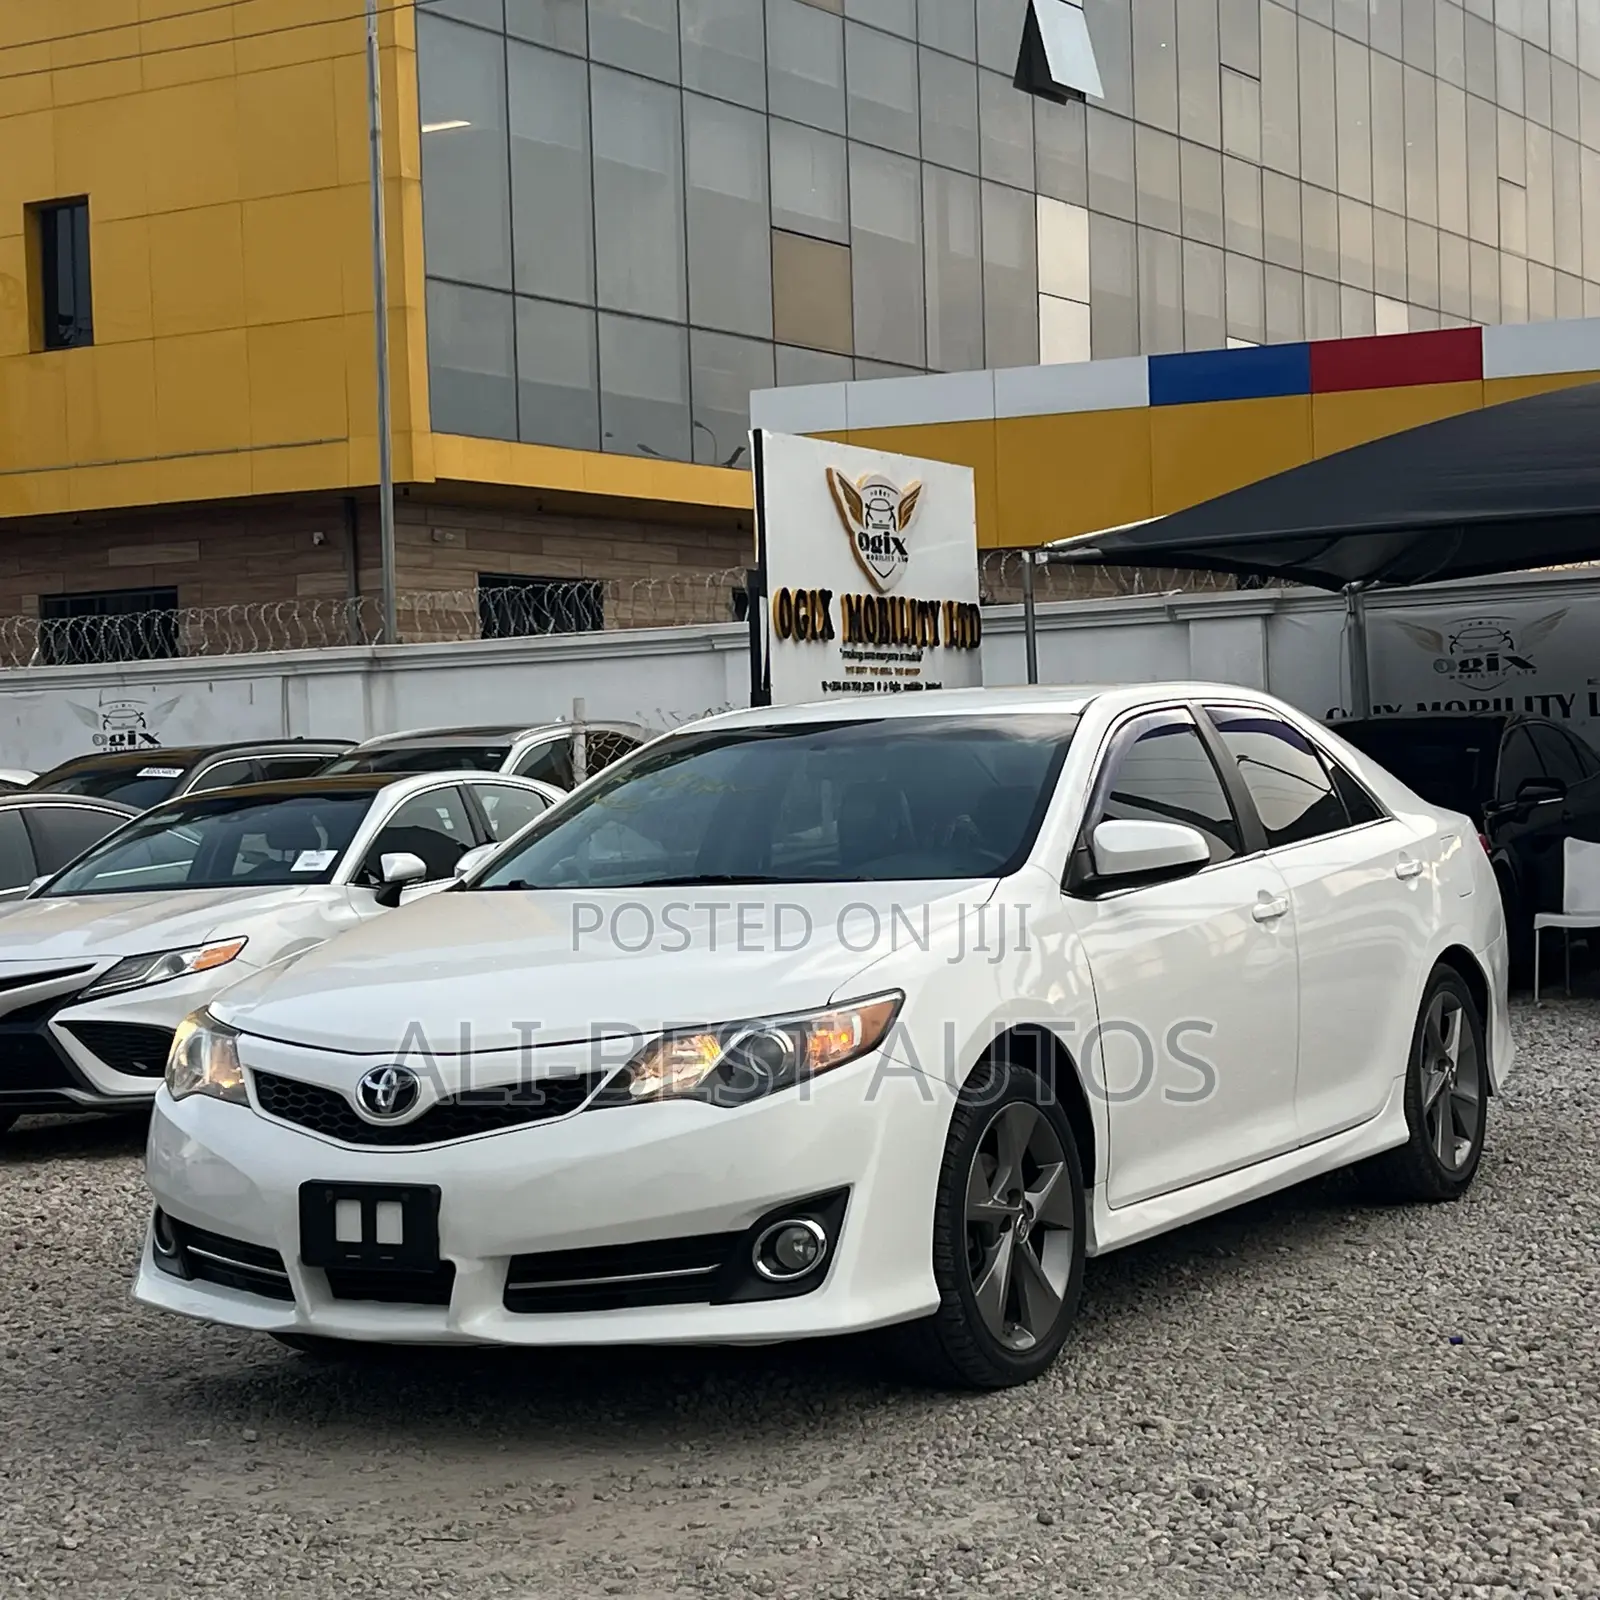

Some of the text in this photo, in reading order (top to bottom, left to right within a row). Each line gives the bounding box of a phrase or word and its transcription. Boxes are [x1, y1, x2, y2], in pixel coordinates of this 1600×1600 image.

[774, 587, 981, 649] OGIX MOBILITY LTD
